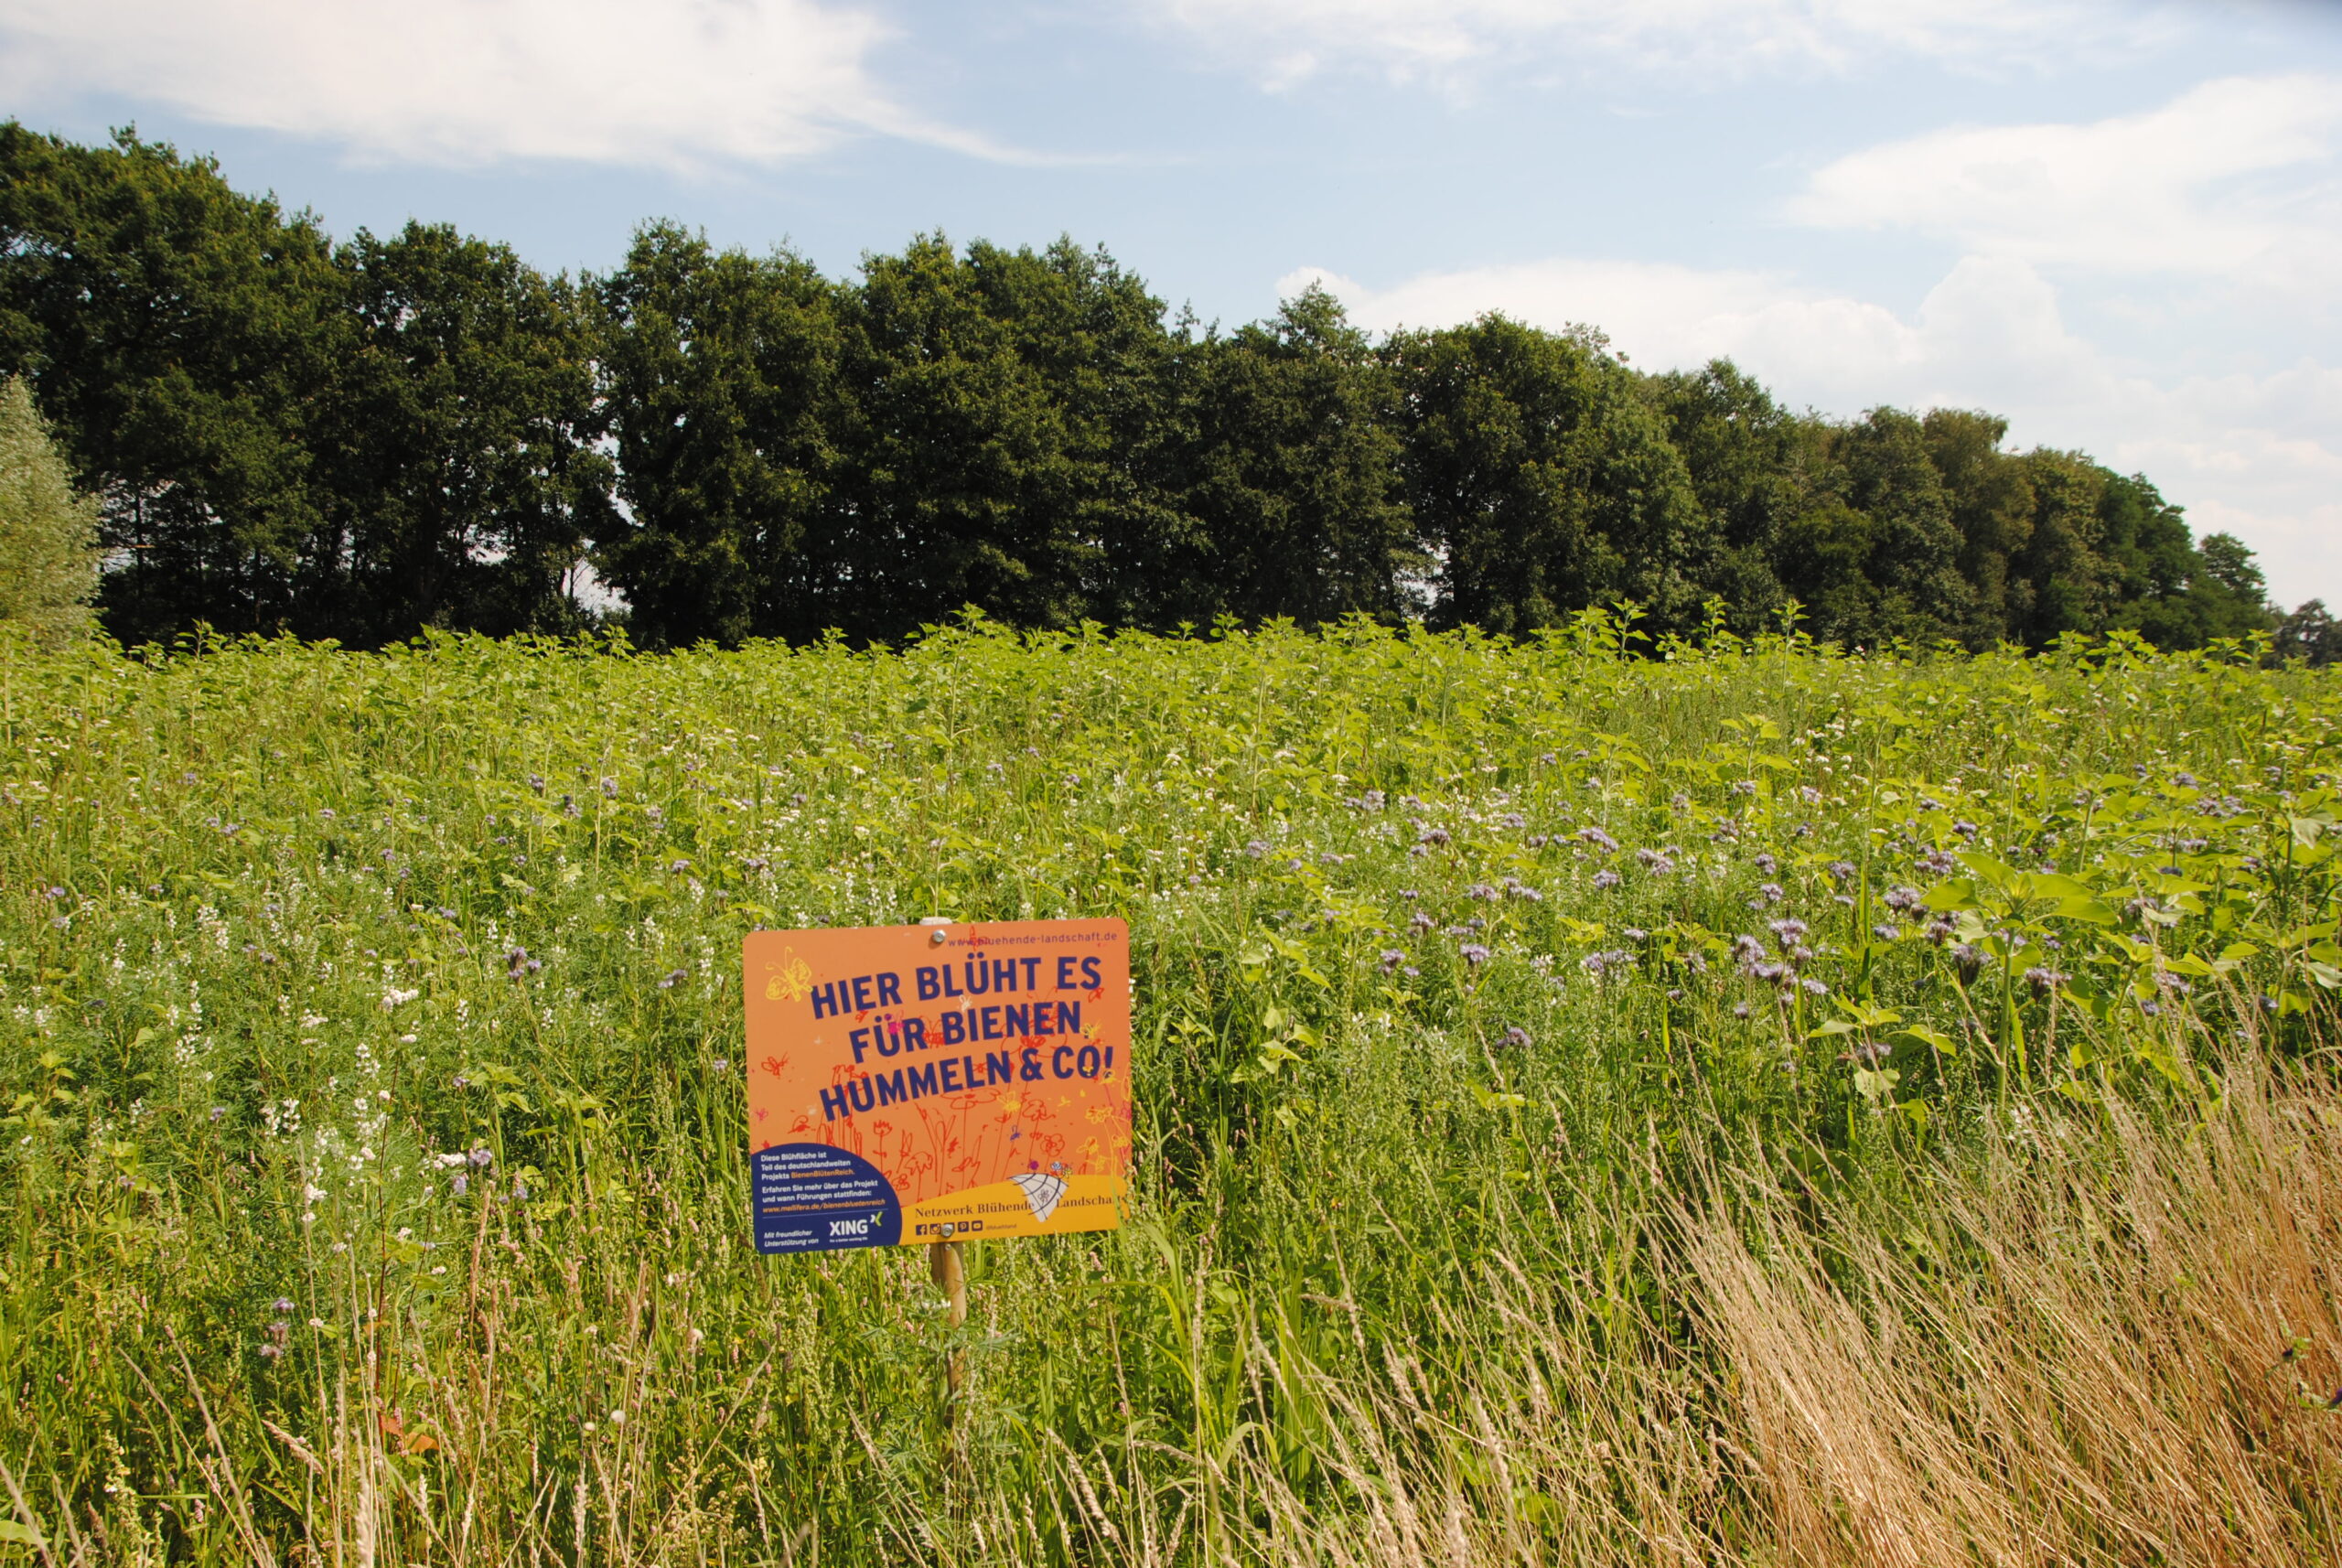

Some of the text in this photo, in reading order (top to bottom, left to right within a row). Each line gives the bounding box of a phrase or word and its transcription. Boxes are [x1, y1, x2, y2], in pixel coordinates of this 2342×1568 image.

[811, 952, 1101, 1019] HIER BLÜHT ES
[849, 1014, 929, 1064] FÜR
[820, 1051, 1012, 1122] HUMMELN
[1019, 1048, 1044, 1081] &
[788, 1160, 851, 1169] deutschlandweiten
[854, 1180, 878, 1188] Projekt
[915, 1202, 973, 1219] Netzwerk
[830, 1219, 868, 1236] XING
